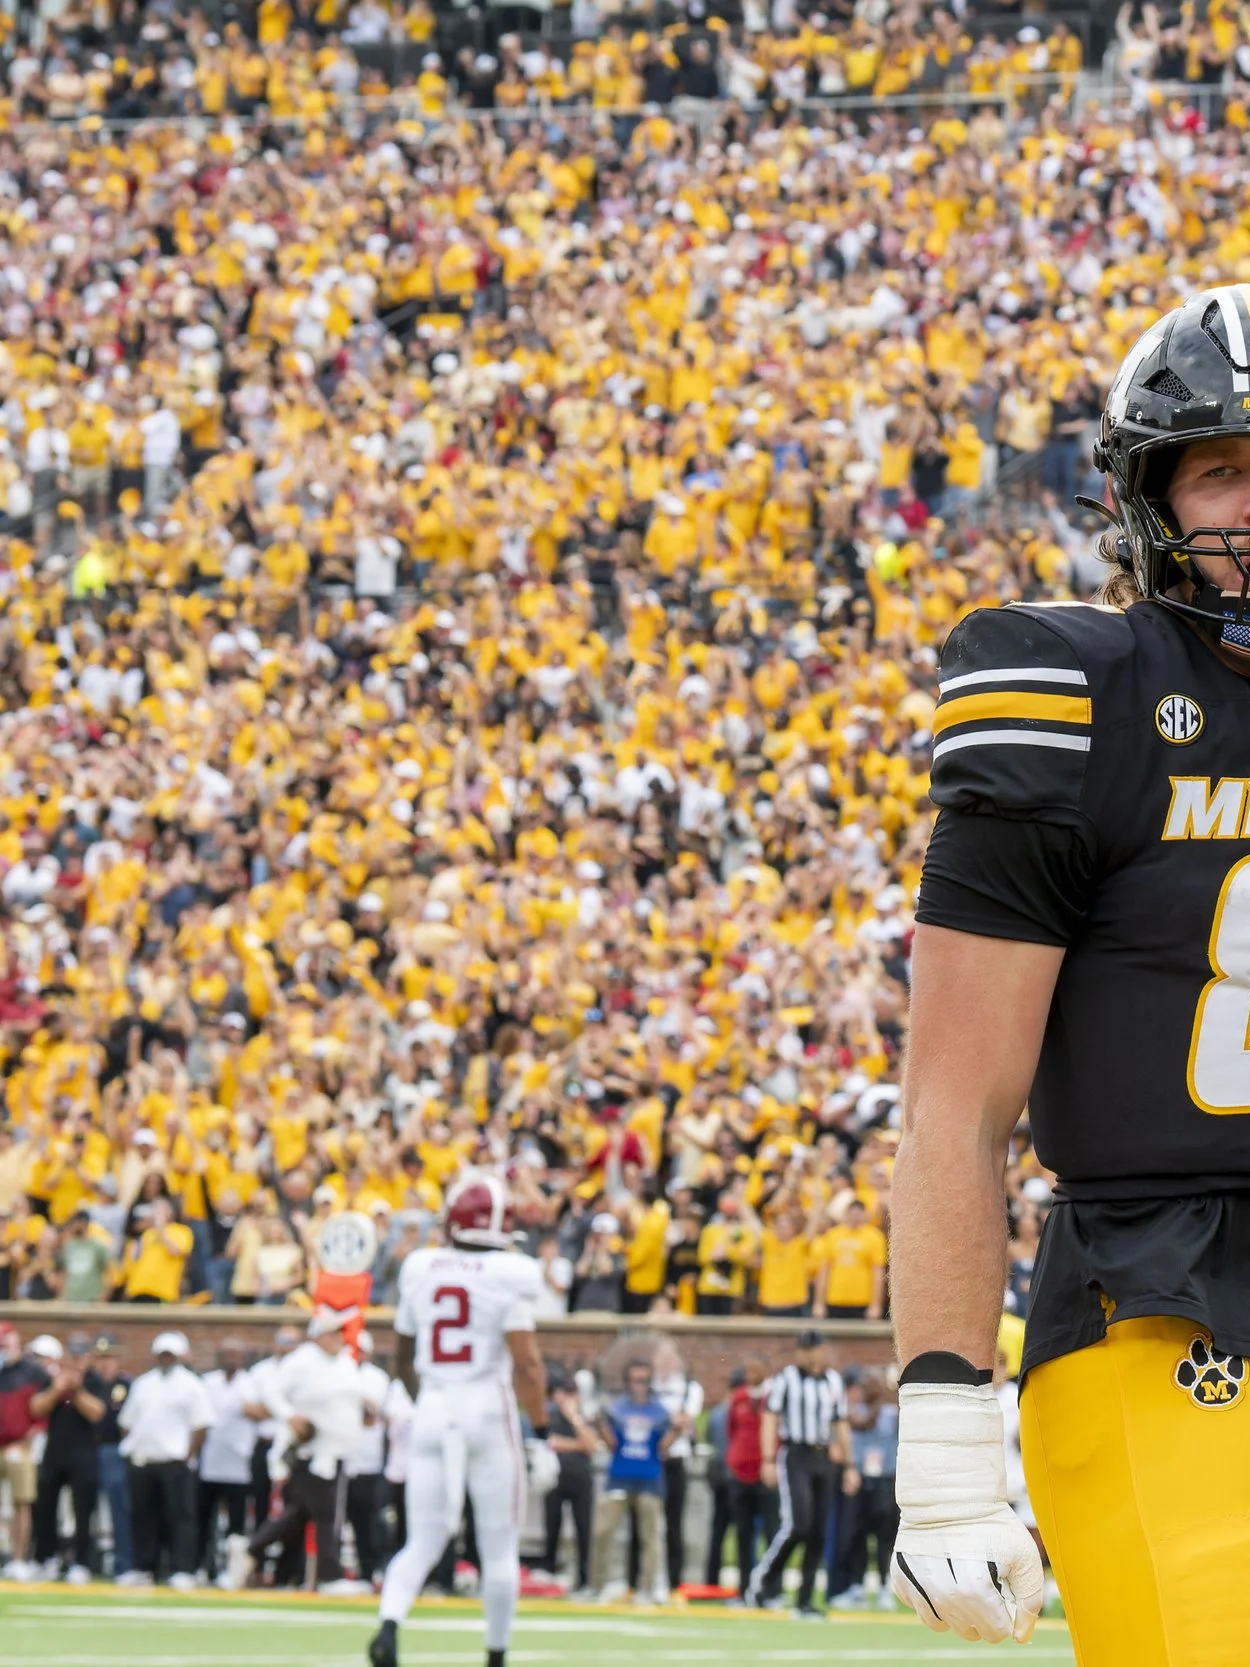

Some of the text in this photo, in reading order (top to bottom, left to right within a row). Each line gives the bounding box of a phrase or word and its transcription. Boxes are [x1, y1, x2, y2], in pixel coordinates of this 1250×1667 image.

[1159, 697, 1199, 740] SEC
[431, 1285, 473, 1364] 2
[1201, 1379, 1232, 1402] M
